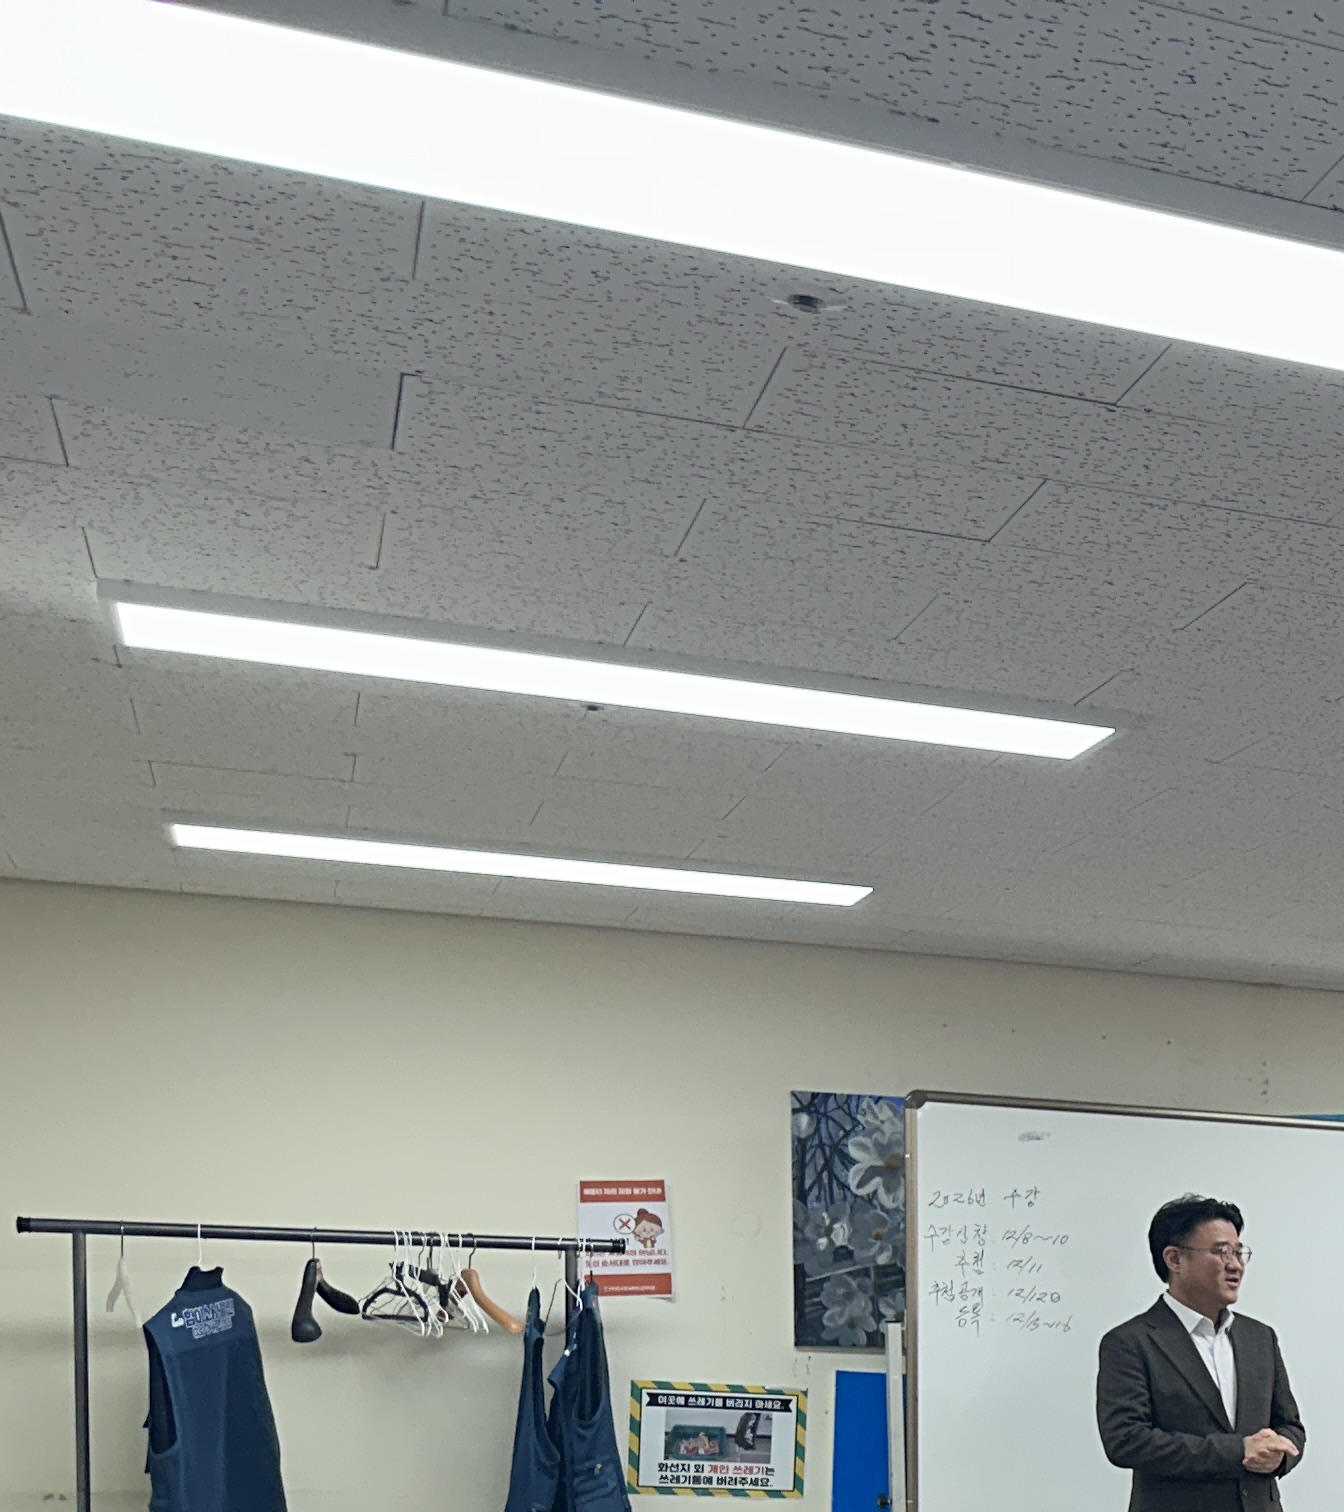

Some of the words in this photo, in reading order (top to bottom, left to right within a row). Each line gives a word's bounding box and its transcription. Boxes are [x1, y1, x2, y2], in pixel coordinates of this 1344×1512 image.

[657, 1395, 685, 1405] 이곳에
[688, 1397, 723, 1407] 쓰레기를
[726, 1398, 752, 1408] 버리지
[658, 1462, 690, 1473] 화선지
[694, 1463, 704, 1473] 외
[708, 1464, 728, 1474] 개인
[732, 1465, 775, 1476] 쓰레기는
[659, 1475, 713, 1485] 쓰레기통에
